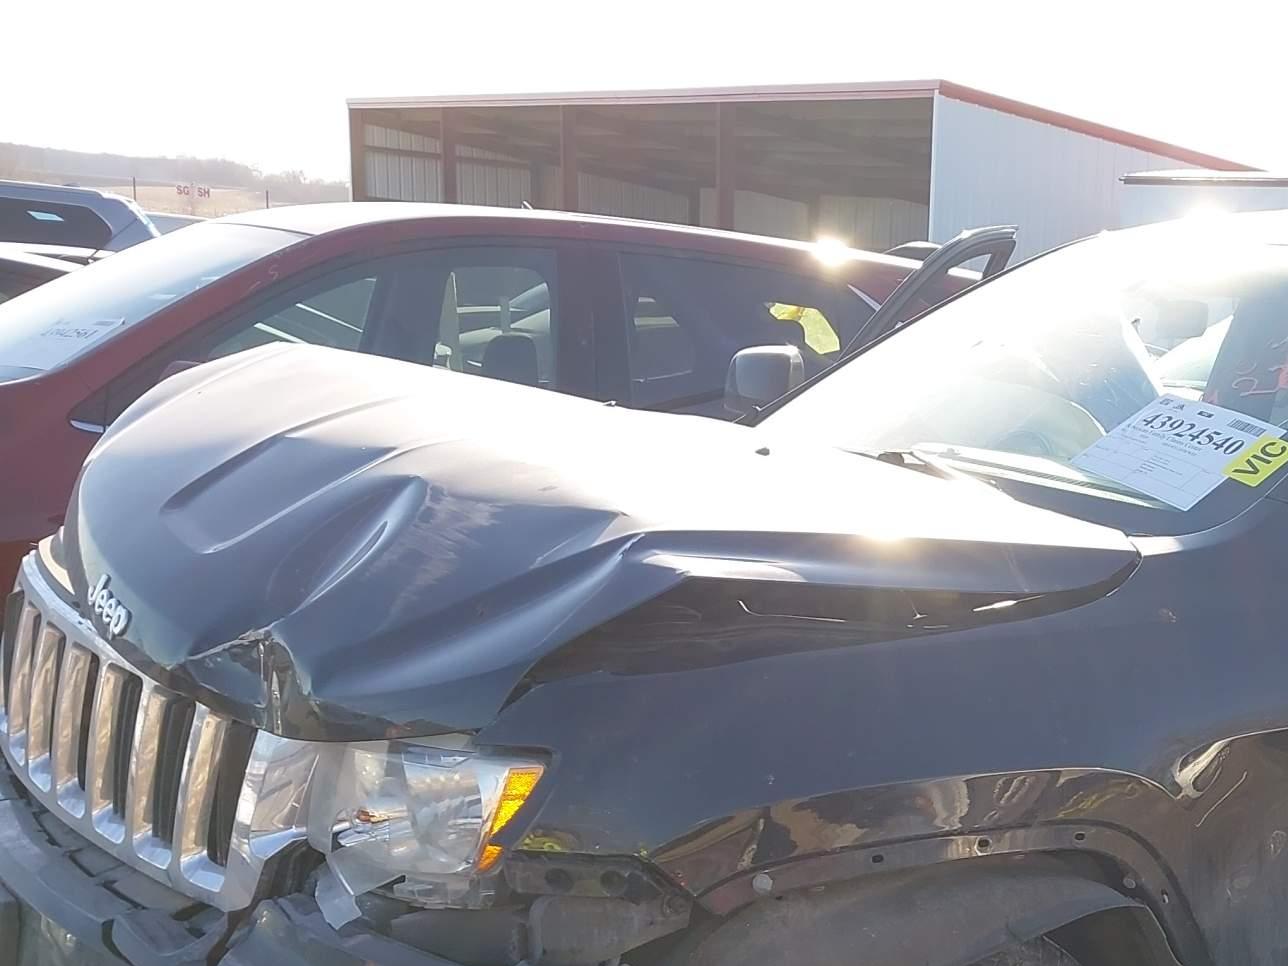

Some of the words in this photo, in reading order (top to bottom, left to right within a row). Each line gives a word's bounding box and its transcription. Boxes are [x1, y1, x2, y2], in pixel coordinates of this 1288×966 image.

[1143, 413, 1245, 455] 43924540
[1231, 441, 1287, 475] VIC
[88, 574, 130, 640] Jeep
